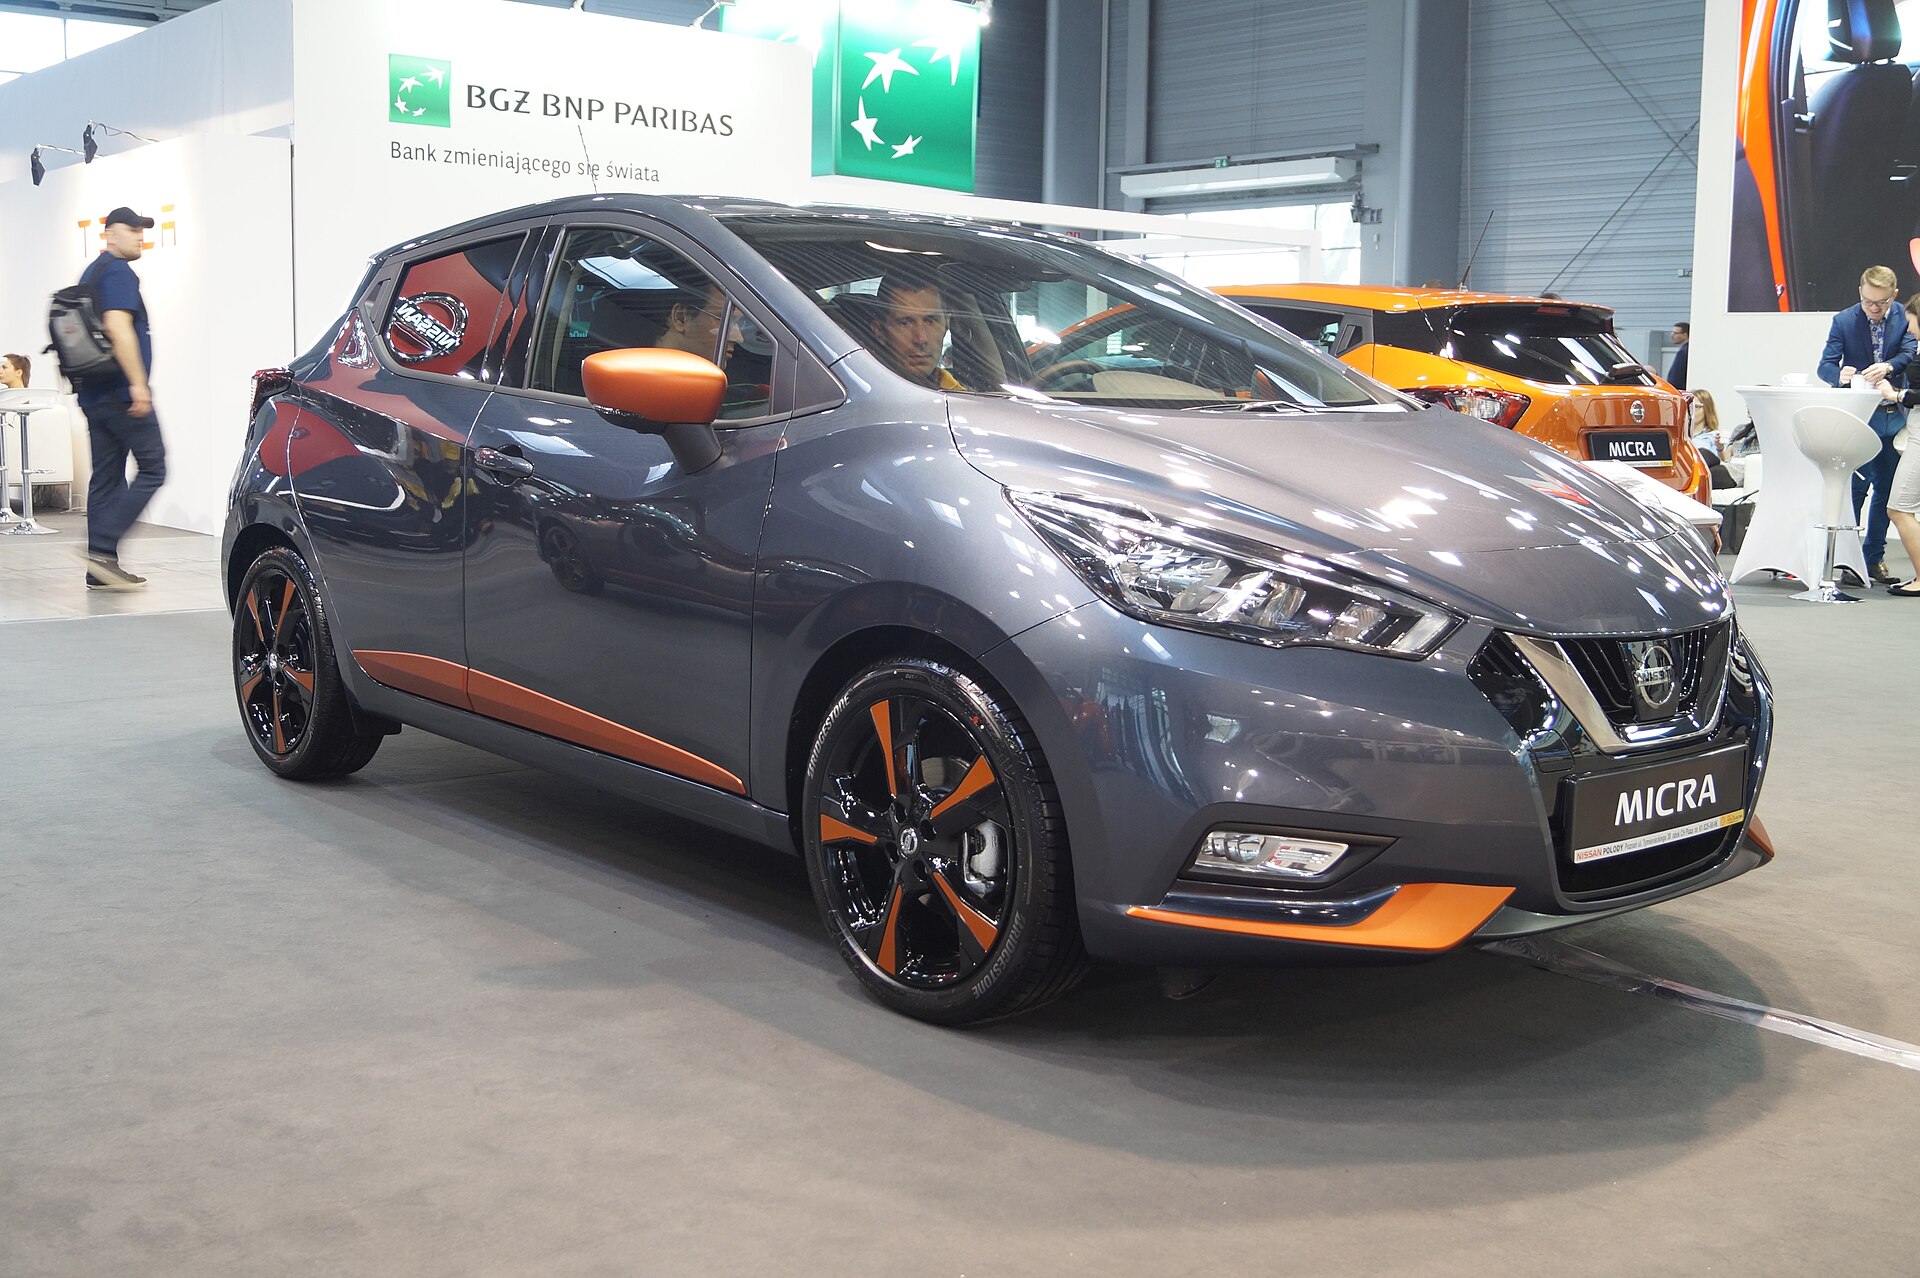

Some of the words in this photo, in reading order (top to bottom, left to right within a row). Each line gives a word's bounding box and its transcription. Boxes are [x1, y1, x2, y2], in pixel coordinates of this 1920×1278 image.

[542, 93, 604, 121] BNP
[614, 101, 734, 137] PARIBAS
[390, 141, 437, 163] Bank
[443, 147, 571, 179] zmieniającego
[577, 161, 600, 178] się
[605, 160, 660, 183] świata
[1608, 441, 1657, 457] MICRA
[807, 692, 850, 780] BRIDGESTONE
[1614, 774, 1717, 826] MICRA
[1576, 848, 1602, 860] NISSAN
[1603, 844, 1624, 856] POLODY
[972, 910, 1026, 999] BRIDGESTONE
